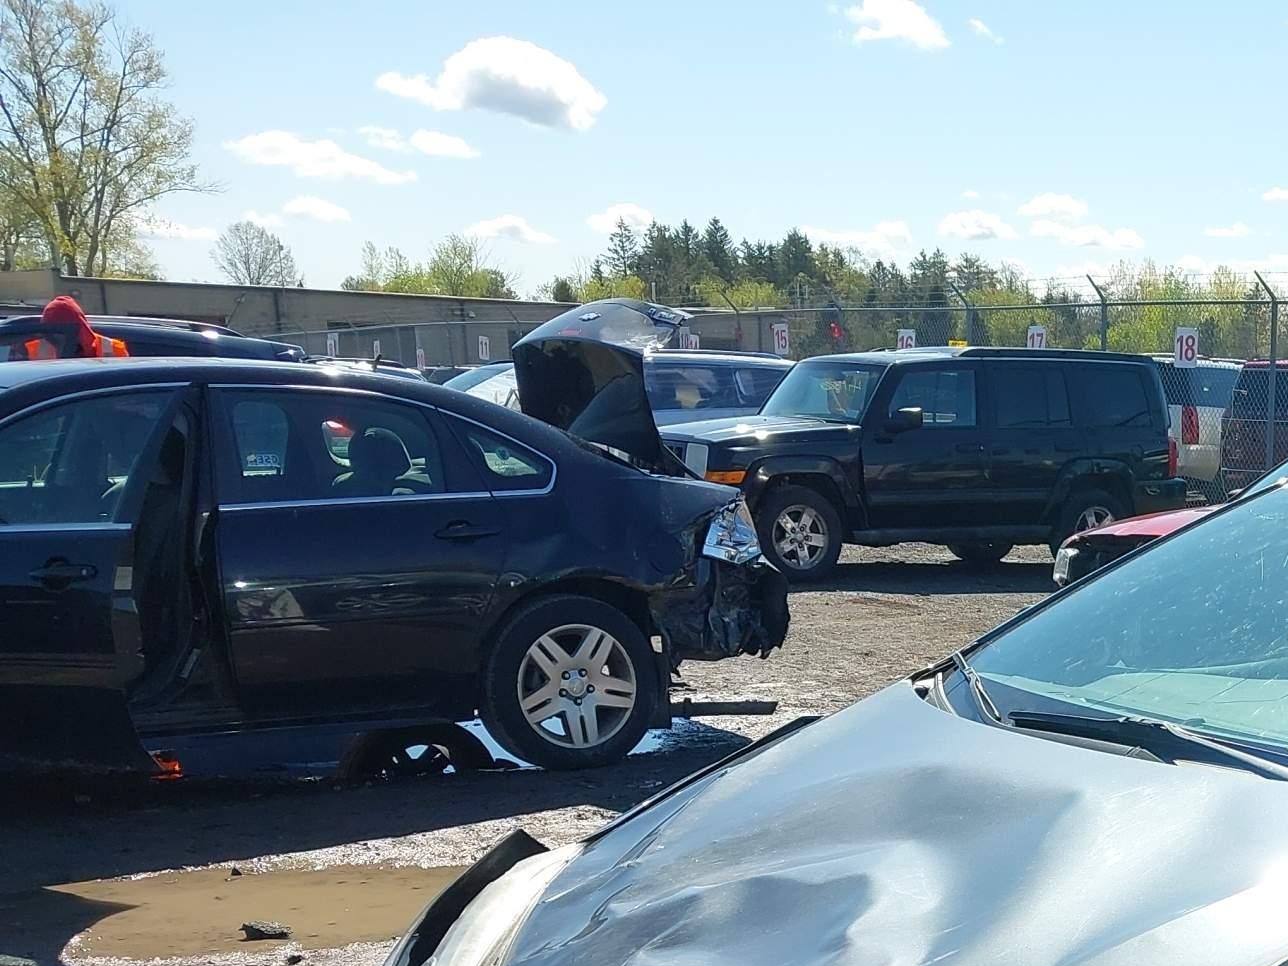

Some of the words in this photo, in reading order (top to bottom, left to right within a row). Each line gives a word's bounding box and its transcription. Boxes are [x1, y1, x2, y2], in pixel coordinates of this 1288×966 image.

[775, 329, 787, 350] 15
[1029, 332, 1044, 349] 17
[1176, 335, 1196, 361] 18
